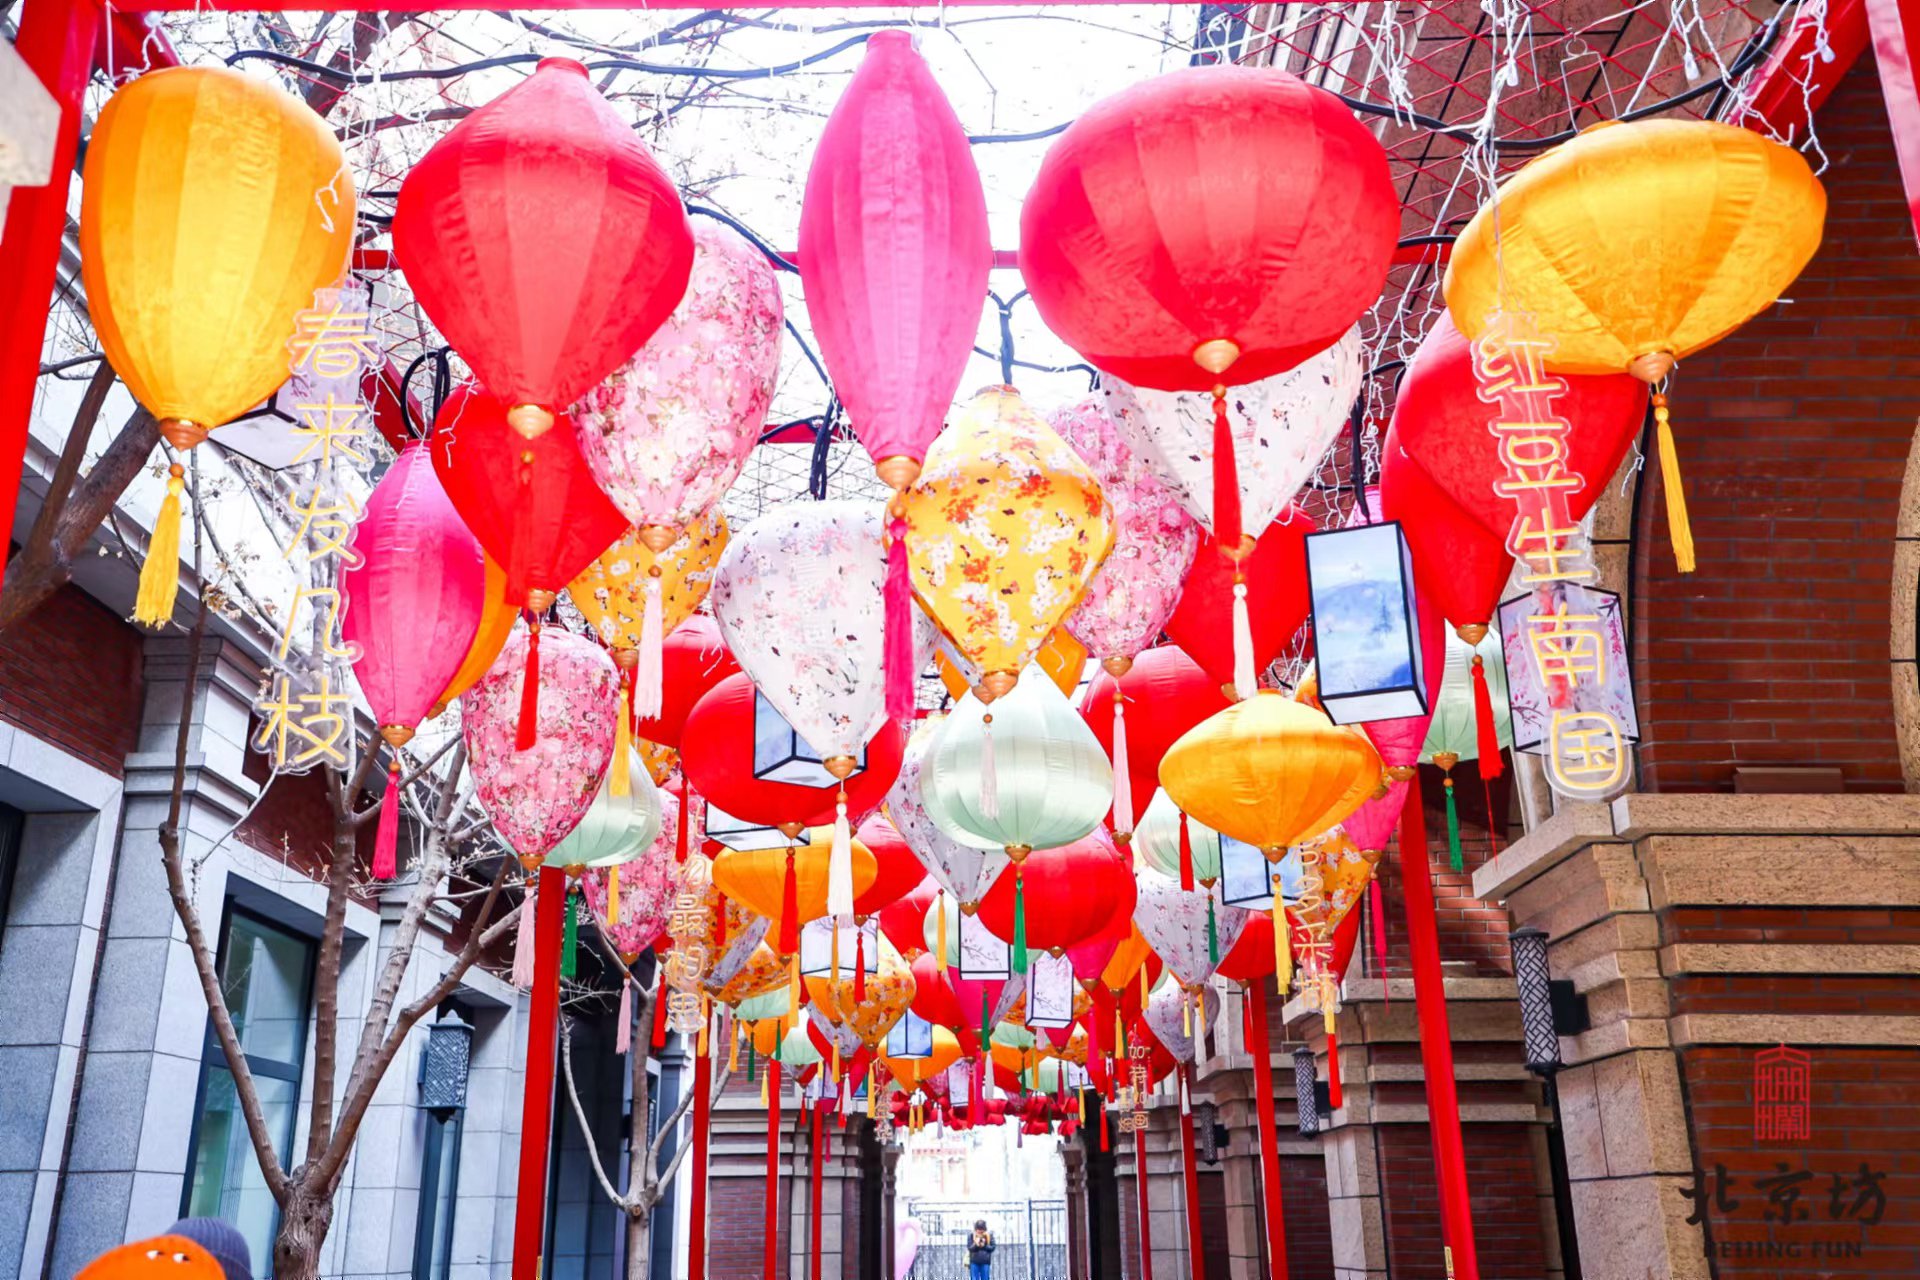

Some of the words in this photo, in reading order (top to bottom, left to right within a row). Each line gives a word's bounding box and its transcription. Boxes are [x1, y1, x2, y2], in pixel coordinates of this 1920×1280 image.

[258, 302, 378, 766] 春来发几枝
[1476, 330, 1624, 790] 红豆生南国
